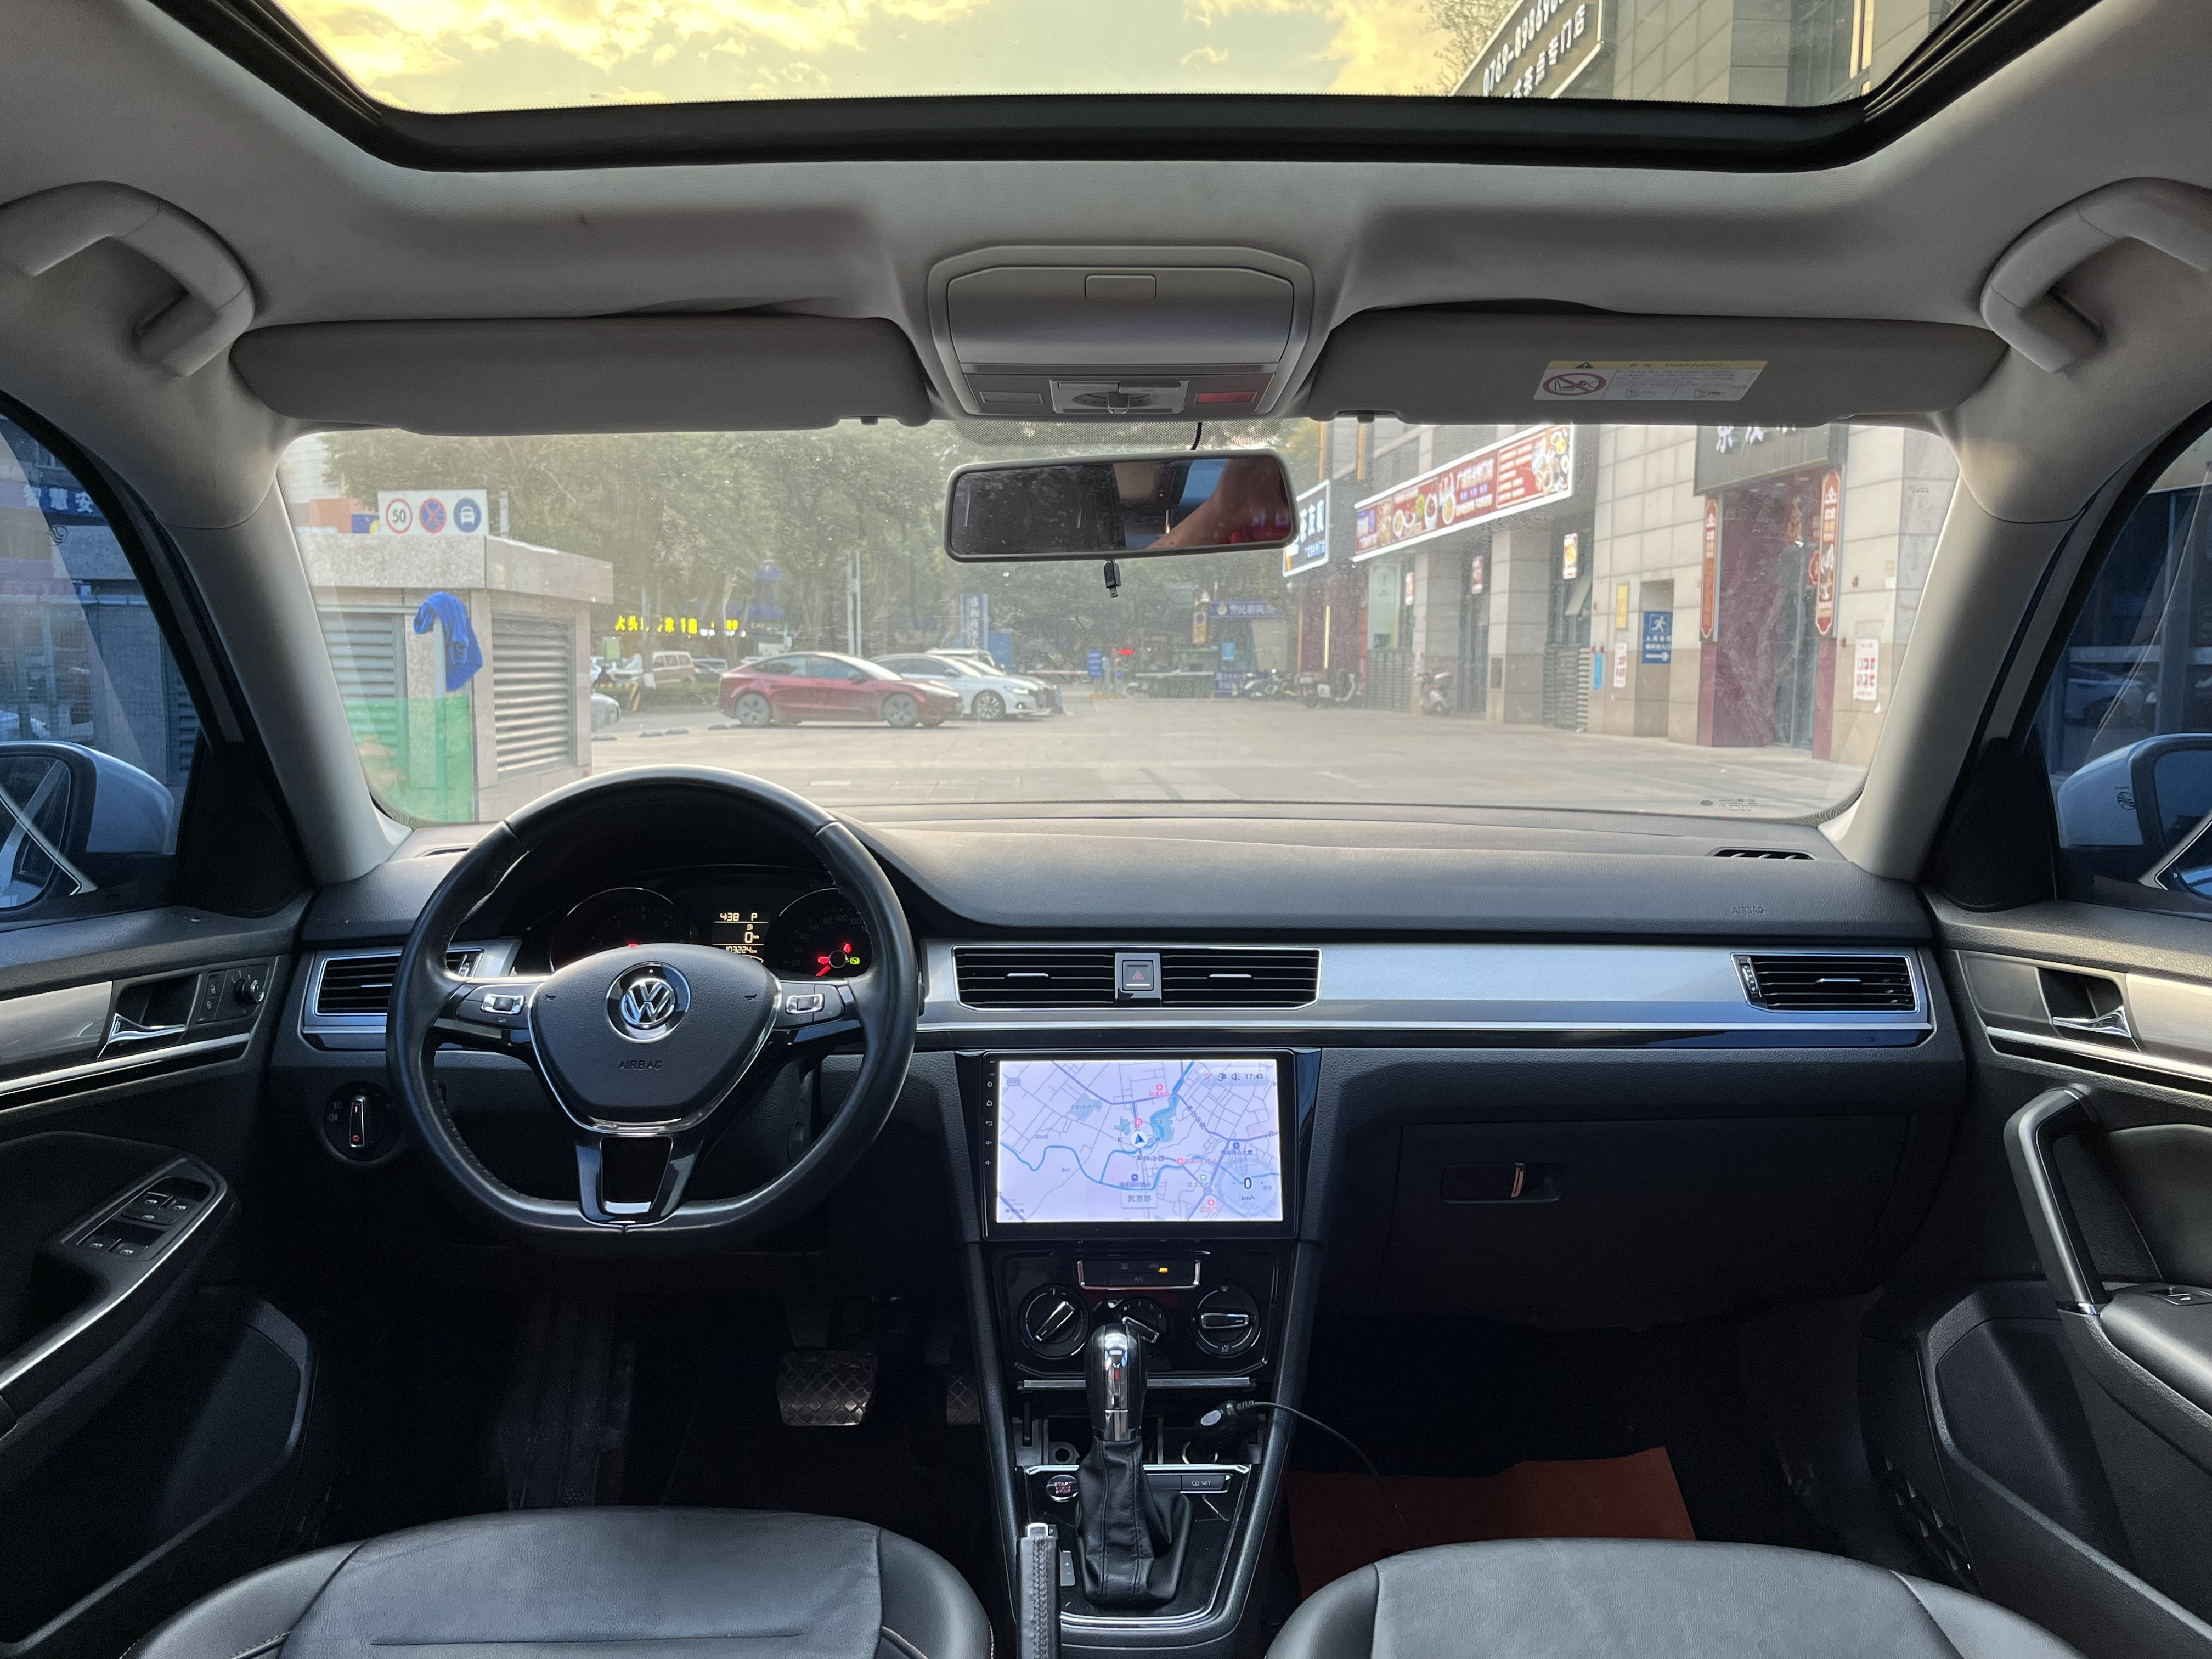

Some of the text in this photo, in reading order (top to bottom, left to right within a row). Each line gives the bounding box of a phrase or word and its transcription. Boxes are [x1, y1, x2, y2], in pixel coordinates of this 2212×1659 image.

[392, 509, 407, 523] 50
[751, 912, 758, 921] P
[744, 931, 753, 944] 0
[618, 1060, 663, 1070] AIRBAG
[1244, 1177, 1252, 1190] 0
